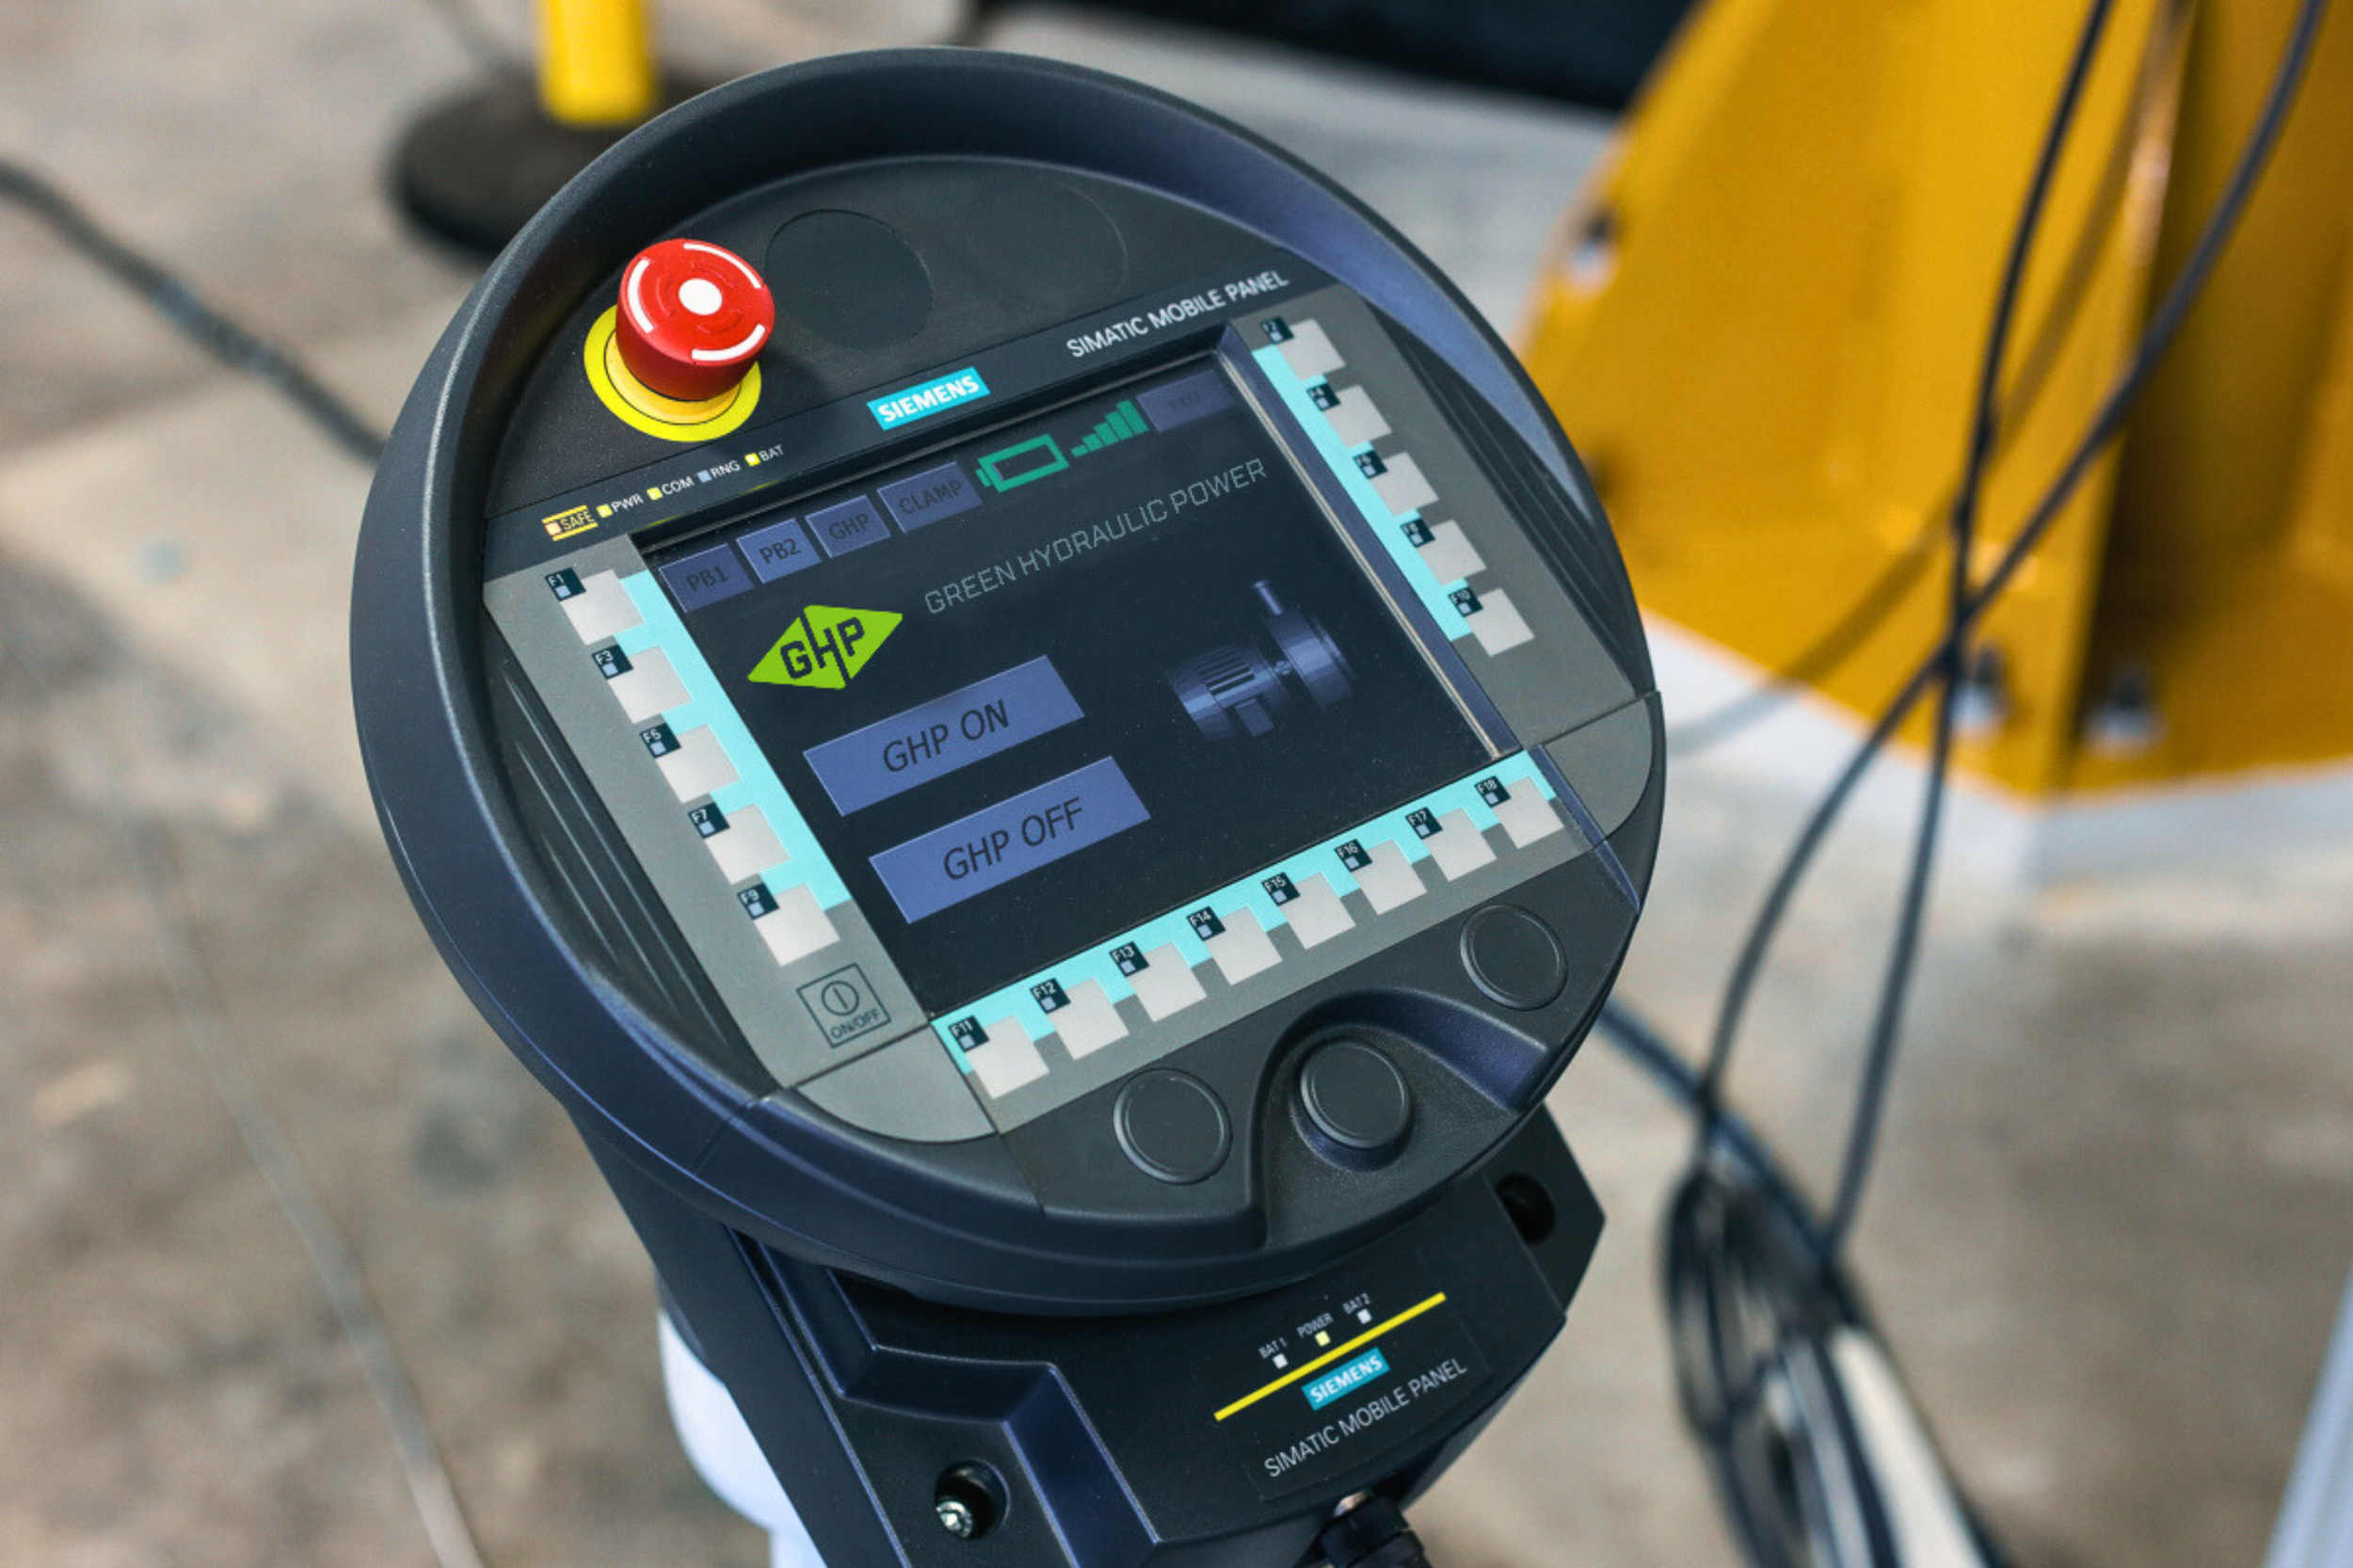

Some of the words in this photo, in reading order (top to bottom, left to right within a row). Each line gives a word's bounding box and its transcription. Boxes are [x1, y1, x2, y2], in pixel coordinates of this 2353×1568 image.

[1066, 317, 1148, 358] SIMATIC
[1147, 289, 1225, 329] MOBILE
[1225, 269, 1290, 302] PANEL
[877, 376, 980, 423] SIEMENS
[759, 444, 785, 461] BAT
[711, 460, 741, 478] RNG
[662, 475, 695, 495] COM
[899, 480, 963, 515] CLAMP
[611, 493, 644, 513] PWR
[560, 511, 595, 531] SAFE
[828, 512, 870, 541] GHP
[924, 560, 1016, 614] GREEN
[1017, 499, 1168, 576] HYDRAULIC
[1170, 457, 1267, 515] POWER
[760, 538, 801, 565] PB2
[549, 573, 564, 587] F1
[685, 565, 729, 593] PB1
[780, 612, 865, 687] GHP
[882, 723, 949, 773] GHP
[960, 698, 1010, 741] ON
[691, 808, 707, 824] F7
[943, 830, 1010, 881] GHP
[1020, 796, 1083, 848] OFF
[1188, 910, 1212, 927] F14
[1112, 946, 1135, 963] F13
[1032, 983, 1055, 1000] F12
[830, 1008, 880, 1039] ON/OFF
[950, 1020, 973, 1037] F11
[1342, 1297, 1362, 1315] BAT
[1296, 1312, 1335, 1338] POWER
[1258, 1340, 1279, 1360] BAT
[1309, 1354, 1384, 1403] SIEMENS
[1264, 1425, 1340, 1478] SIMATIC
[1337, 1386, 1411, 1437] MOBILE
[1408, 1357, 1468, 1398] PANEL
